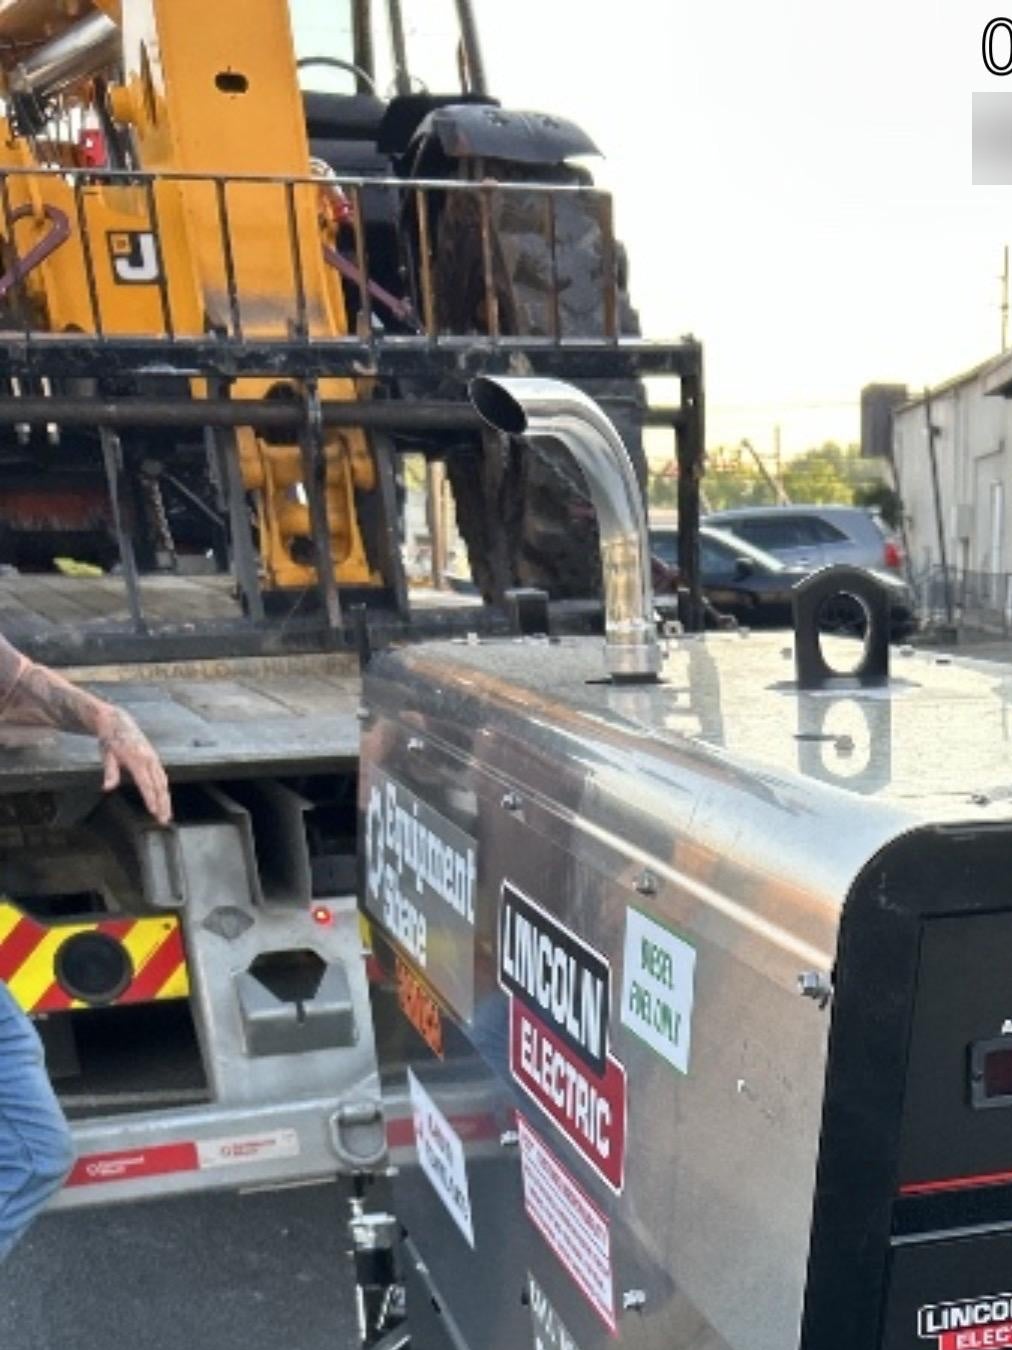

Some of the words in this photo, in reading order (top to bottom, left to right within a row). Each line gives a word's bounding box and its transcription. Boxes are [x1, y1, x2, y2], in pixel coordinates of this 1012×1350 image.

[385, 780, 475, 925] Equipment
[503, 905, 603, 1062] LINCOLN
[520, 1015, 611, 1160] ELECTRIC
